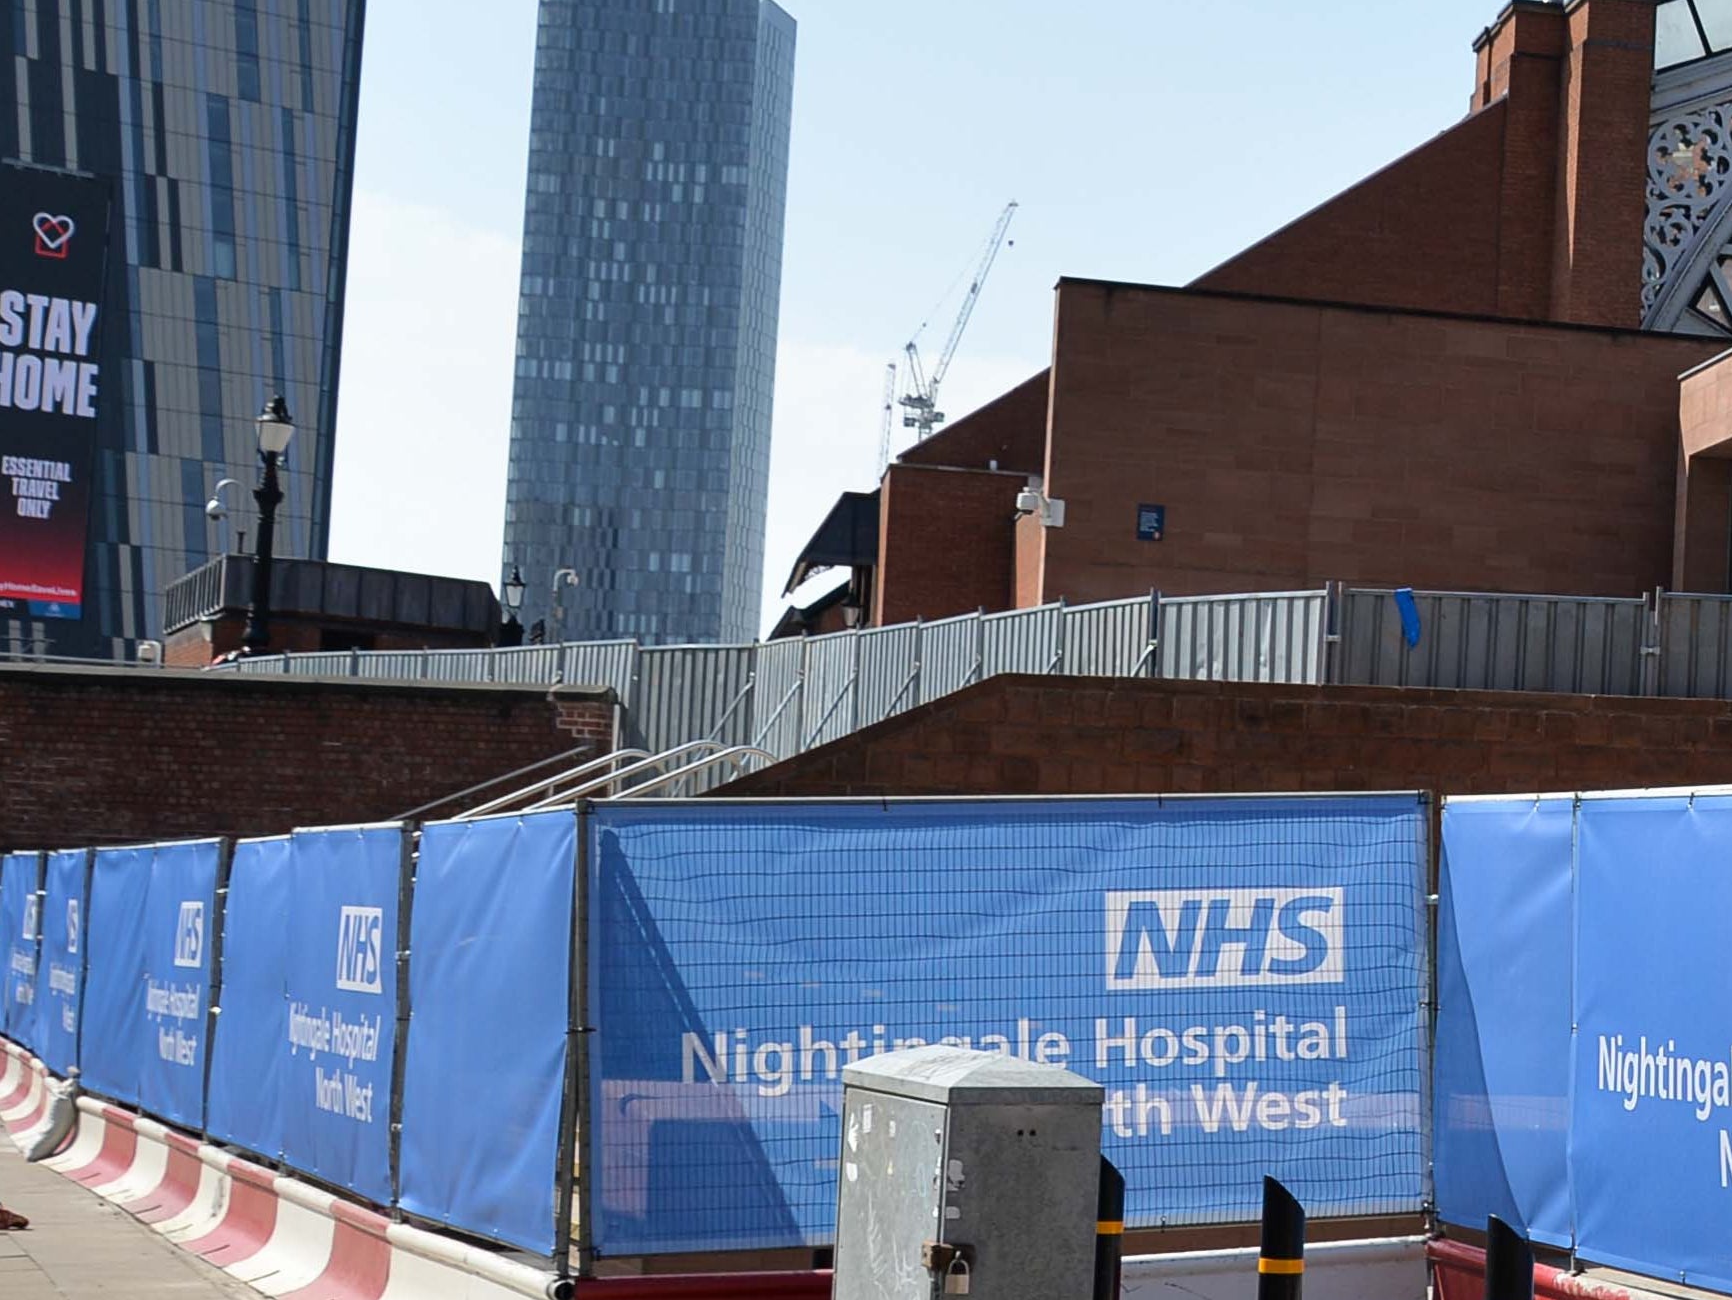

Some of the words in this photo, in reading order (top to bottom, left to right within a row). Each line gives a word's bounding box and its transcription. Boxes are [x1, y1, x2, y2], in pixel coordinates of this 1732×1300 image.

[0, 289, 97, 356] STAY
[1, 455, 72, 482] ESSENTIAL
[11, 476, 60, 500] TRAVEL
[16, 498, 52, 519] ONLY
[339, 913, 381, 986] NHS
[1112, 895, 1336, 980] NHS
[331, 1011, 381, 1070] Hospital
[1095, 1005, 1348, 1078] Hospital
[344, 1073, 373, 1123] West
[1190, 1080, 1348, 1134] West
